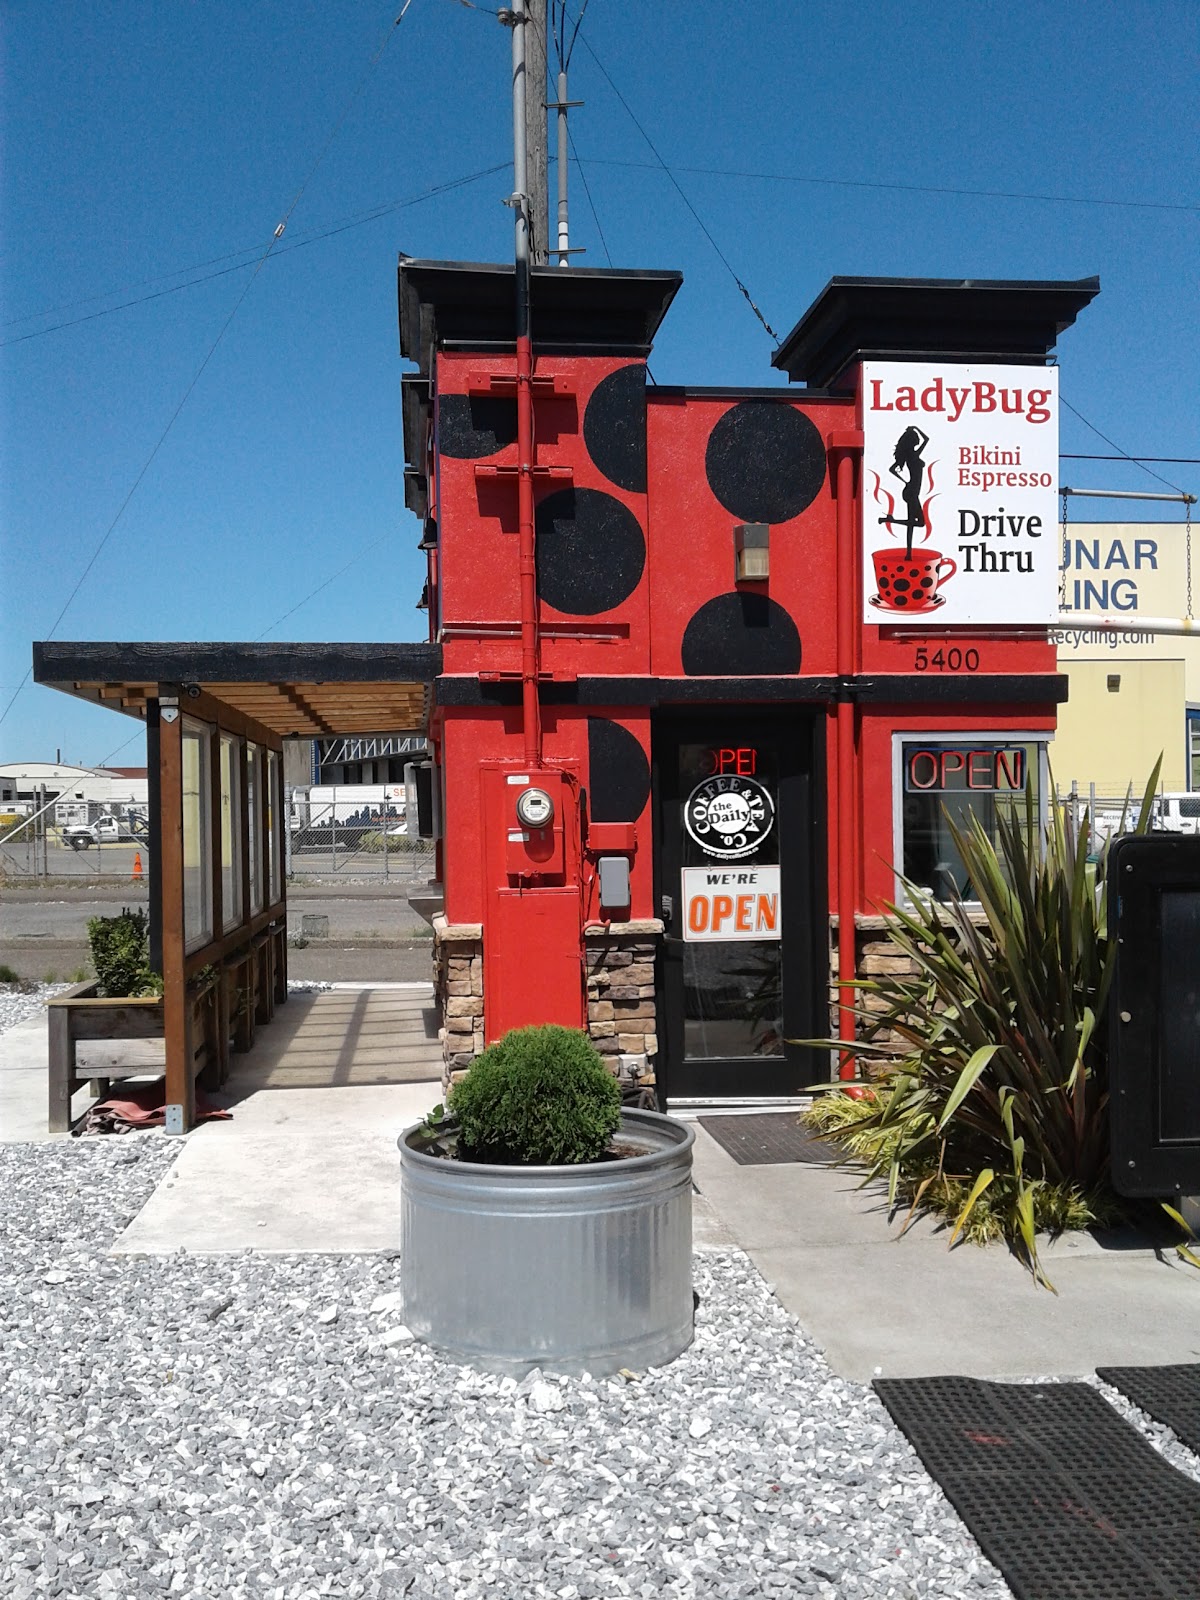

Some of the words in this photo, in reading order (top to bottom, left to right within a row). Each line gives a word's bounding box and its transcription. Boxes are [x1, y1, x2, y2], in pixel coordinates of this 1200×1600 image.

[869, 377, 1052, 424] LadyBug
[958, 445, 1021, 466] Bikini
[957, 468, 1052, 492] Espresso
[957, 507, 1043, 538] Drive
[958, 542, 1035, 573] Thru
[914, 647, 980, 672] 5400
[910, 751, 1021, 790] OPEN
[693, 778, 741, 834] COFFEE
[712, 802, 732, 812] the
[741, 789, 752, 800] &
[708, 809, 750, 824] Daily
[745, 795, 765, 832] TEA
[706, 873, 759, 886] WE'RE
[688, 893, 779, 934] OPEN
